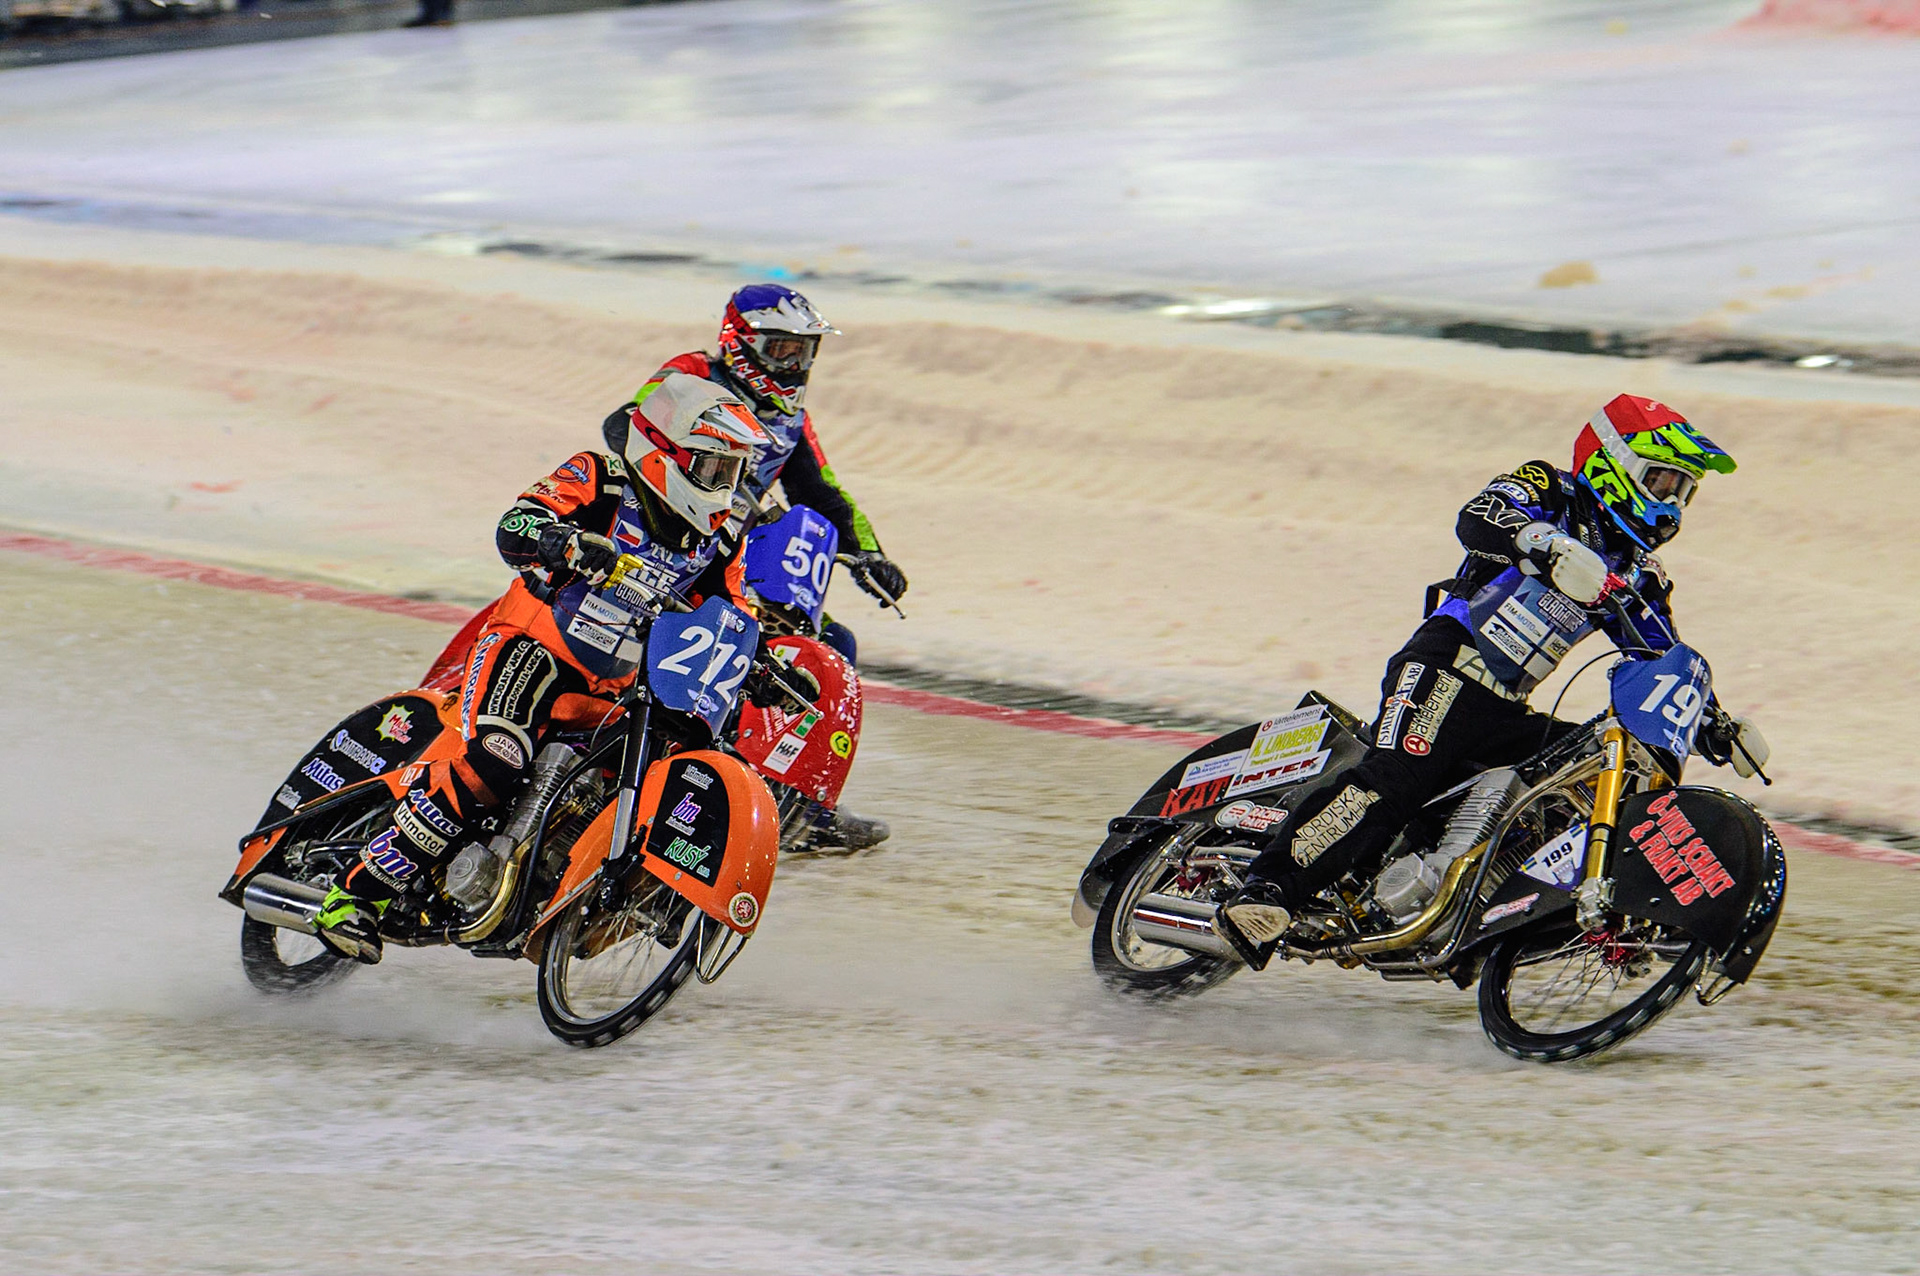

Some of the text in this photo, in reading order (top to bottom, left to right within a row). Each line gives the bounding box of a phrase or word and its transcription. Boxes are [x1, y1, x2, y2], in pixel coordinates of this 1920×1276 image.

[651, 542, 674, 566] 212
[781, 536, 829, 594] 50
[657, 625, 751, 704] 212
[1639, 674, 1703, 733] 19
[494, 736, 520, 757] JAWA
[1264, 721, 1326, 756] LINDBERGS
[301, 757, 345, 793] Mitas
[397, 804, 444, 853] VHmotor
[408, 788, 463, 837] Mitas
[1250, 805, 1287, 822] RACING
[664, 836, 711, 870] KUSÝ
[1541, 842, 1573, 868] 199
[1629, 819, 1705, 906] & FRAKT AB
[1647, 790, 1736, 898] Ö-VIKS SCHAKT
